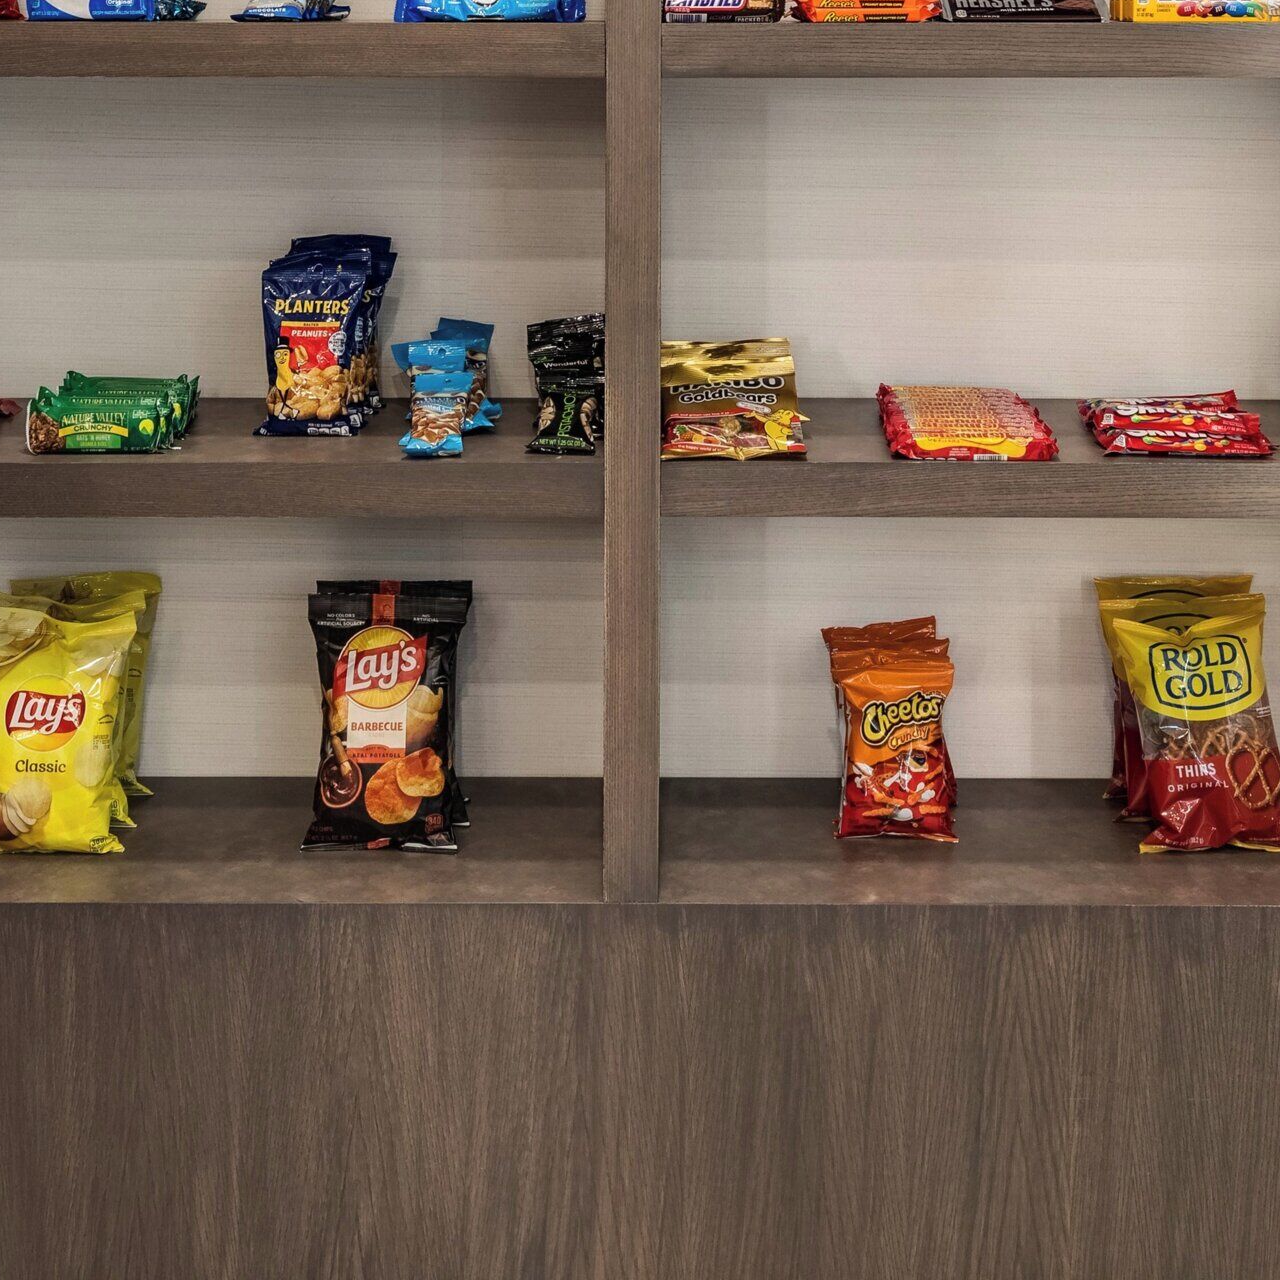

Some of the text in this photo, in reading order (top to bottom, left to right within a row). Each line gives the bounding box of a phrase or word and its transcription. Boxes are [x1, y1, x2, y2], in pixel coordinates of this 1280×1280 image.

[824, 11, 859, 22] Reese's
[276, 299, 349, 315] PLANTERS
[543, 359, 588, 369] Wonderful
[679, 390, 777, 404] Goldbears
[61, 412, 126, 426] NATURE VALLEY
[73, 424, 112, 433] CRUNCHY
[1160, 641, 1237, 672] ROLD
[345, 640, 417, 693] Lay's
[1165, 670, 1243, 700] GOLD
[9, 692, 82, 735] Lay's
[863, 693, 940, 742] Cheetos
[350, 721, 403, 731] BARBECUE
[889, 726, 929, 750] Crunchy
[15, 760, 66, 774] Classic
[1176, 763, 1216, 777] THINS
[1167, 779, 1229, 793] ORIGINAL
